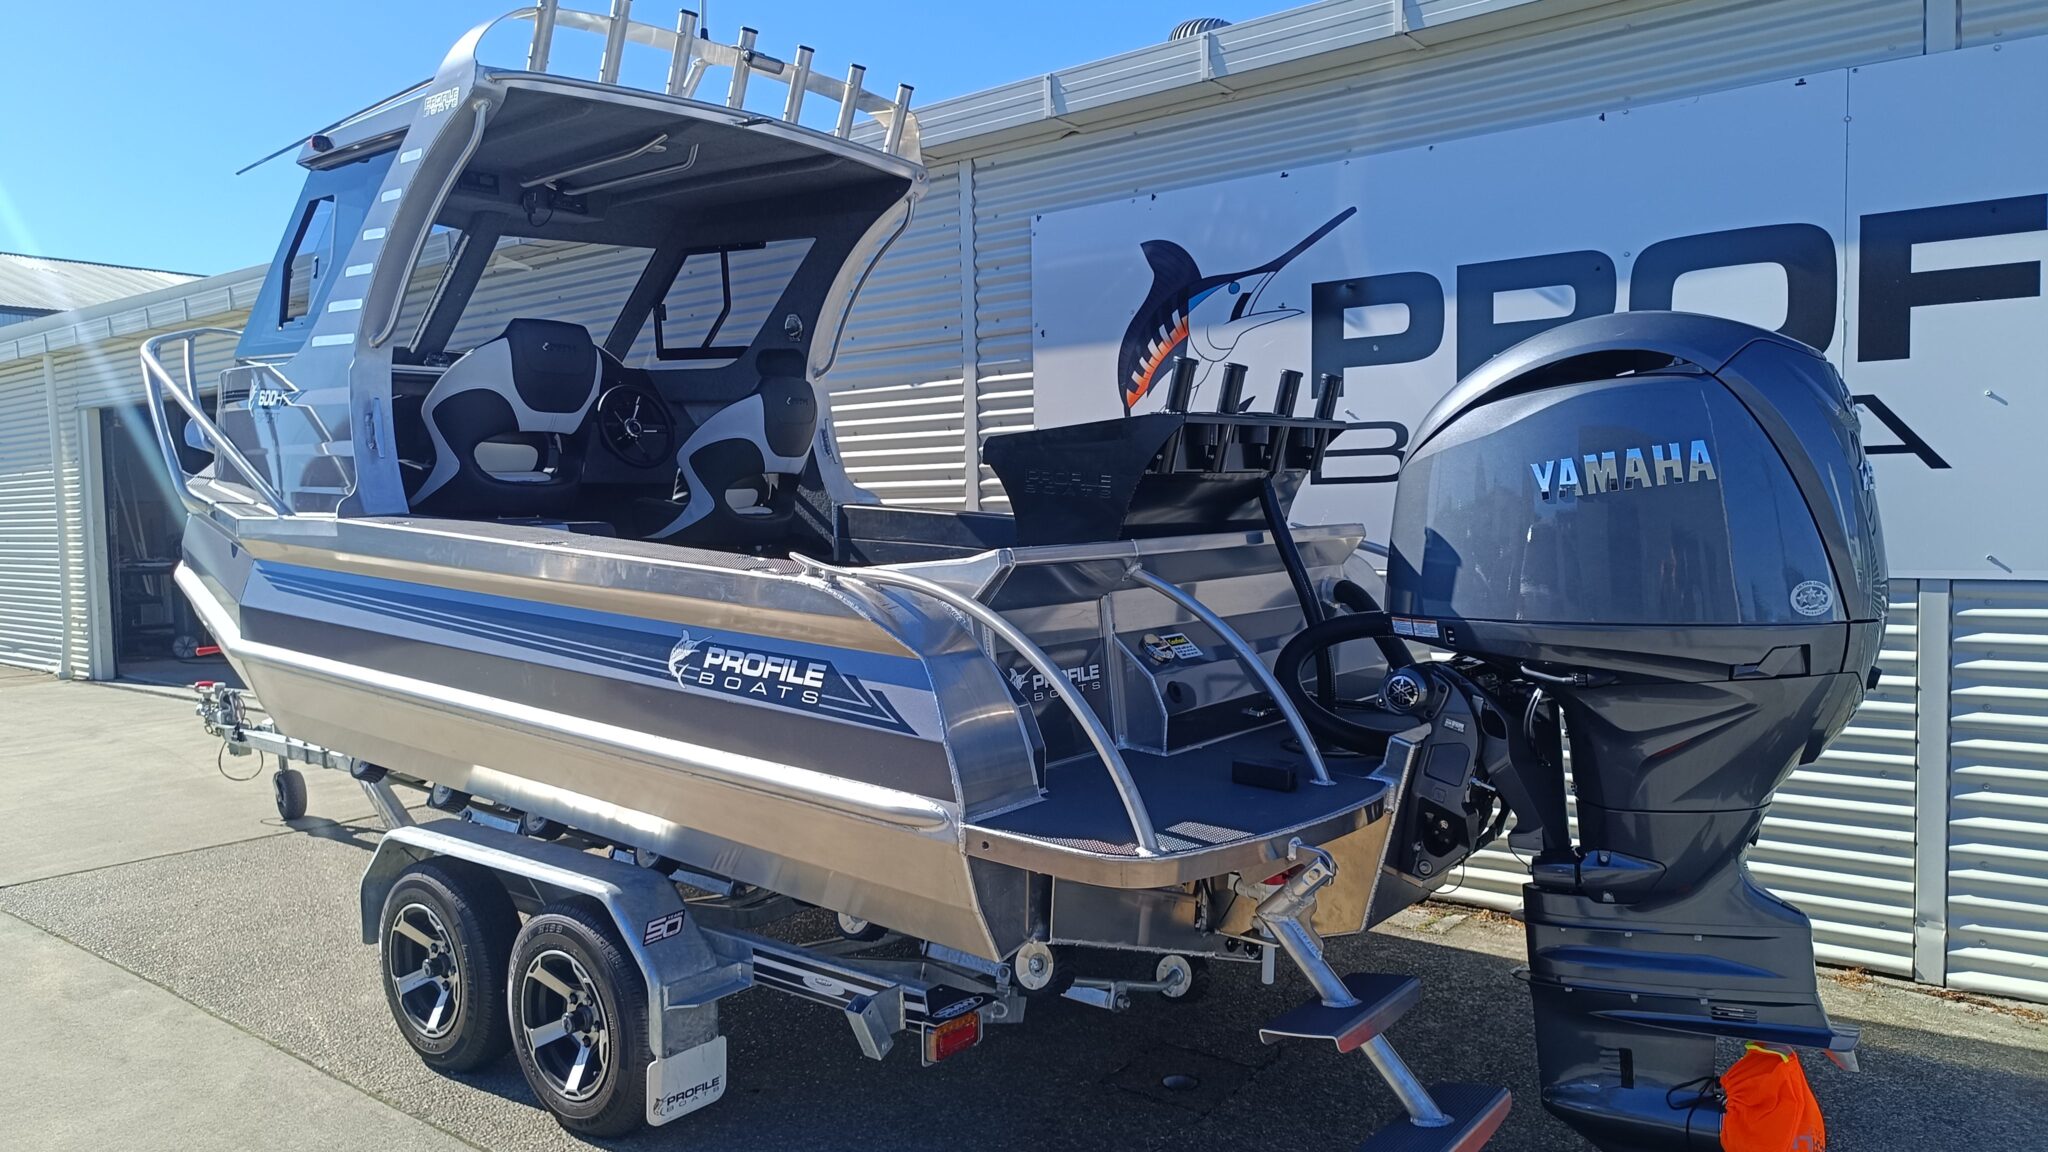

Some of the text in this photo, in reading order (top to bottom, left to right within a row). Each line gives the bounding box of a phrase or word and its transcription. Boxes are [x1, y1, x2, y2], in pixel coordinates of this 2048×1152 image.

[1530, 440, 1717, 500] YAMAHA
[704, 647, 827, 688] PROFILE
[1033, 664, 1100, 690] PFILE
[698, 672, 820, 704] BOATS
[1034, 681, 1101, 701] BOTS
[645, 917, 682, 940] 50
[666, 1086, 720, 1112] BOATS
[667, 1076, 720, 1106] PROFILE
